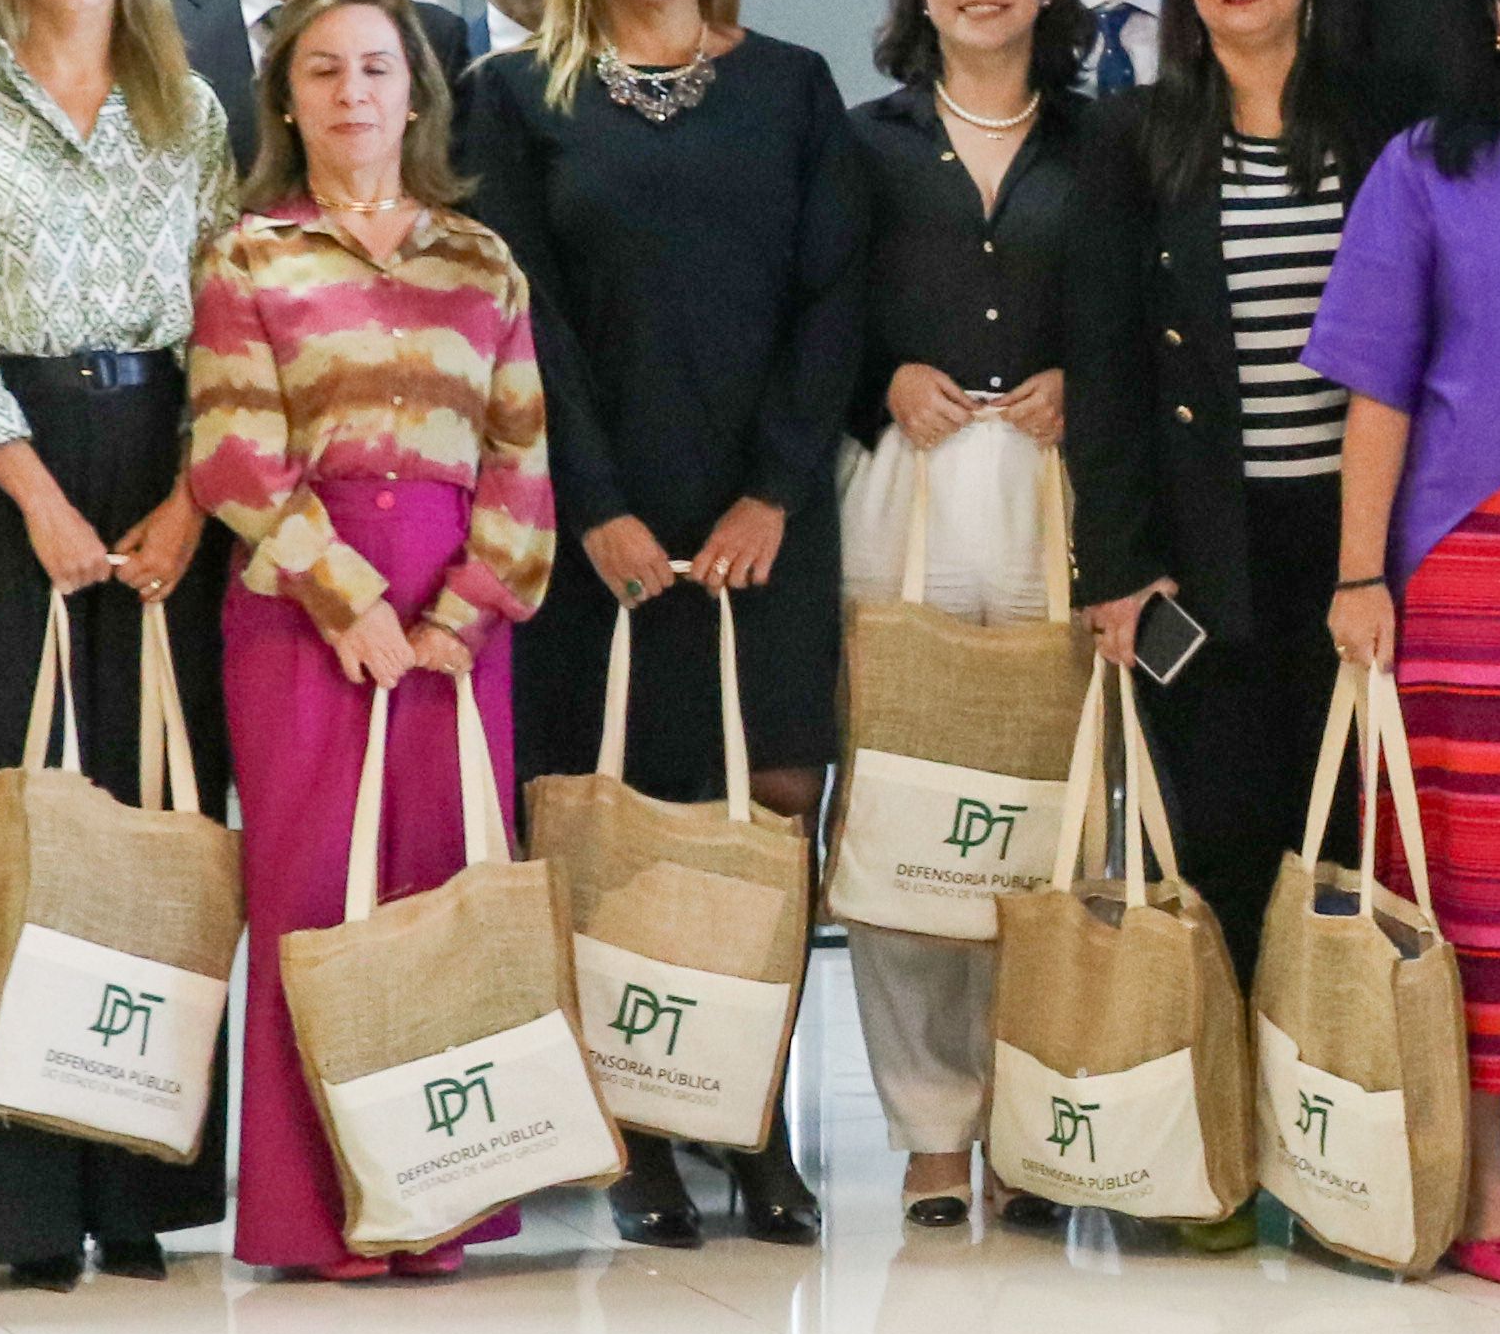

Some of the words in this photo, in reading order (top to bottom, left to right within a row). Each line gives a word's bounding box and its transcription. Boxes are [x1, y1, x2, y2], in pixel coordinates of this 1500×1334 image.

[896, 863, 987, 886] DEFENSORIA
[44, 1049, 125, 1079] DEFENSORIA
[657, 1068, 721, 1092] PÚBLICA
[397, 1142, 488, 1185] DEFENSORIA
[490, 1119, 555, 1150] PÚBLICA
[1088, 1169, 1150, 1191] PÚBLICA
